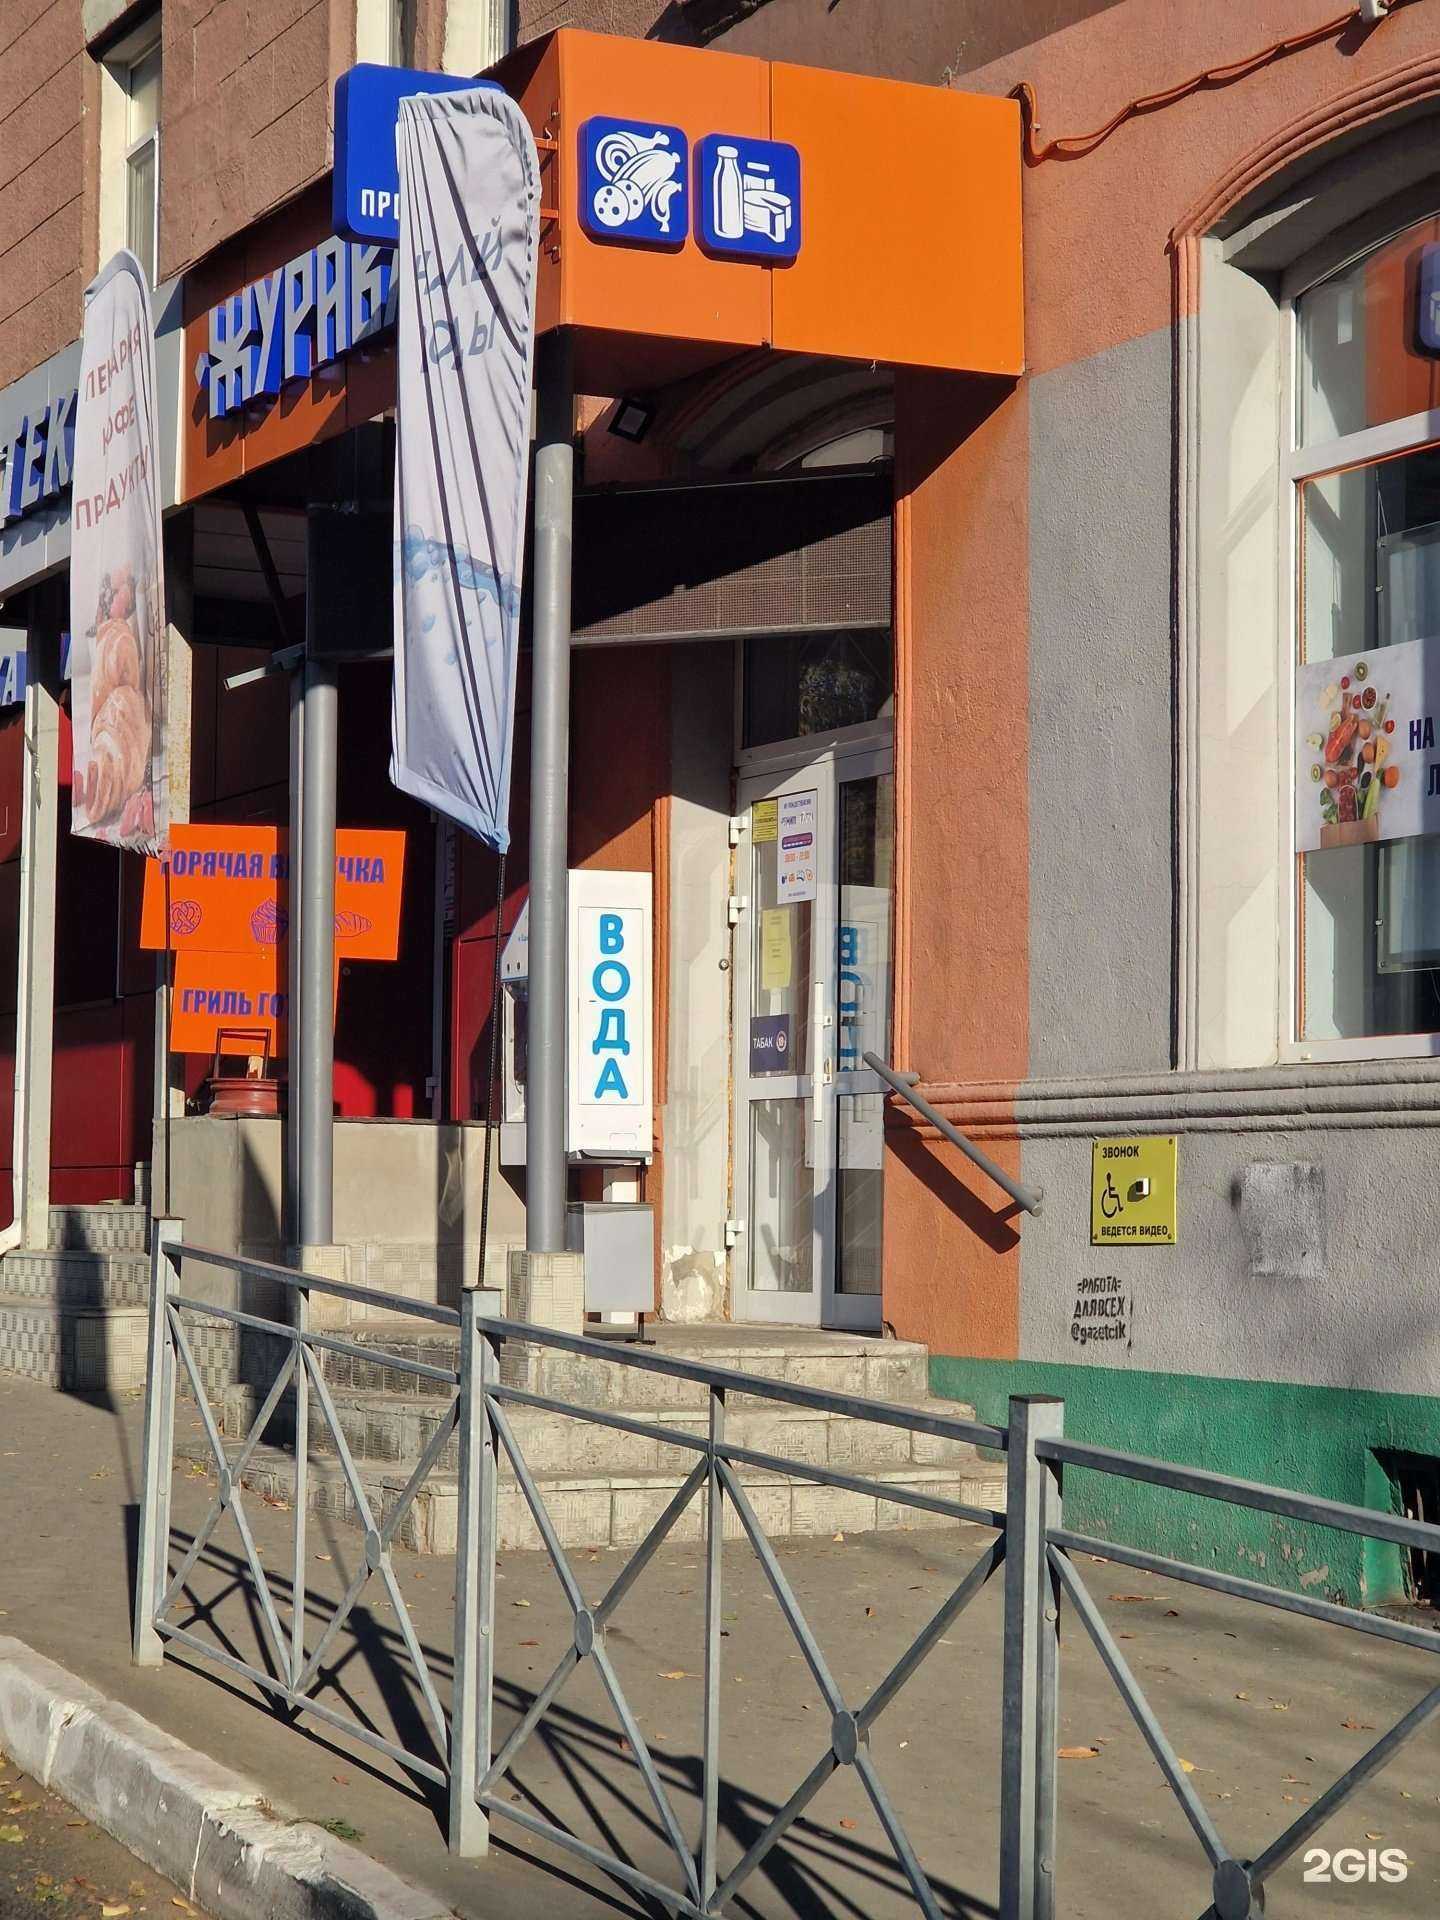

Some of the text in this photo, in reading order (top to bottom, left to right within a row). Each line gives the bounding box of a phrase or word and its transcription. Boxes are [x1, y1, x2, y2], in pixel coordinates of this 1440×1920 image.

[194, 235, 400, 419] ЖУРАВ
[0, 386, 79, 530] ТЕК
[1409, 717, 1435, 751] НА
[161, 850, 385, 884] ОРЯЧАЯ ВЧКА
[182, 989, 289, 1017] ГРИЛЬ ГО
[592, 913, 631, 1100] ВОДА
[752, 1037, 774, 1049] ТАБАК
[1102, 1145, 1140, 1159] ЗВОНОК
[1101, 1225, 1169, 1238] ВЕДЕТСЯ ВИДЕО
[1071, 1318, 1127, 1345] @gazetcik
